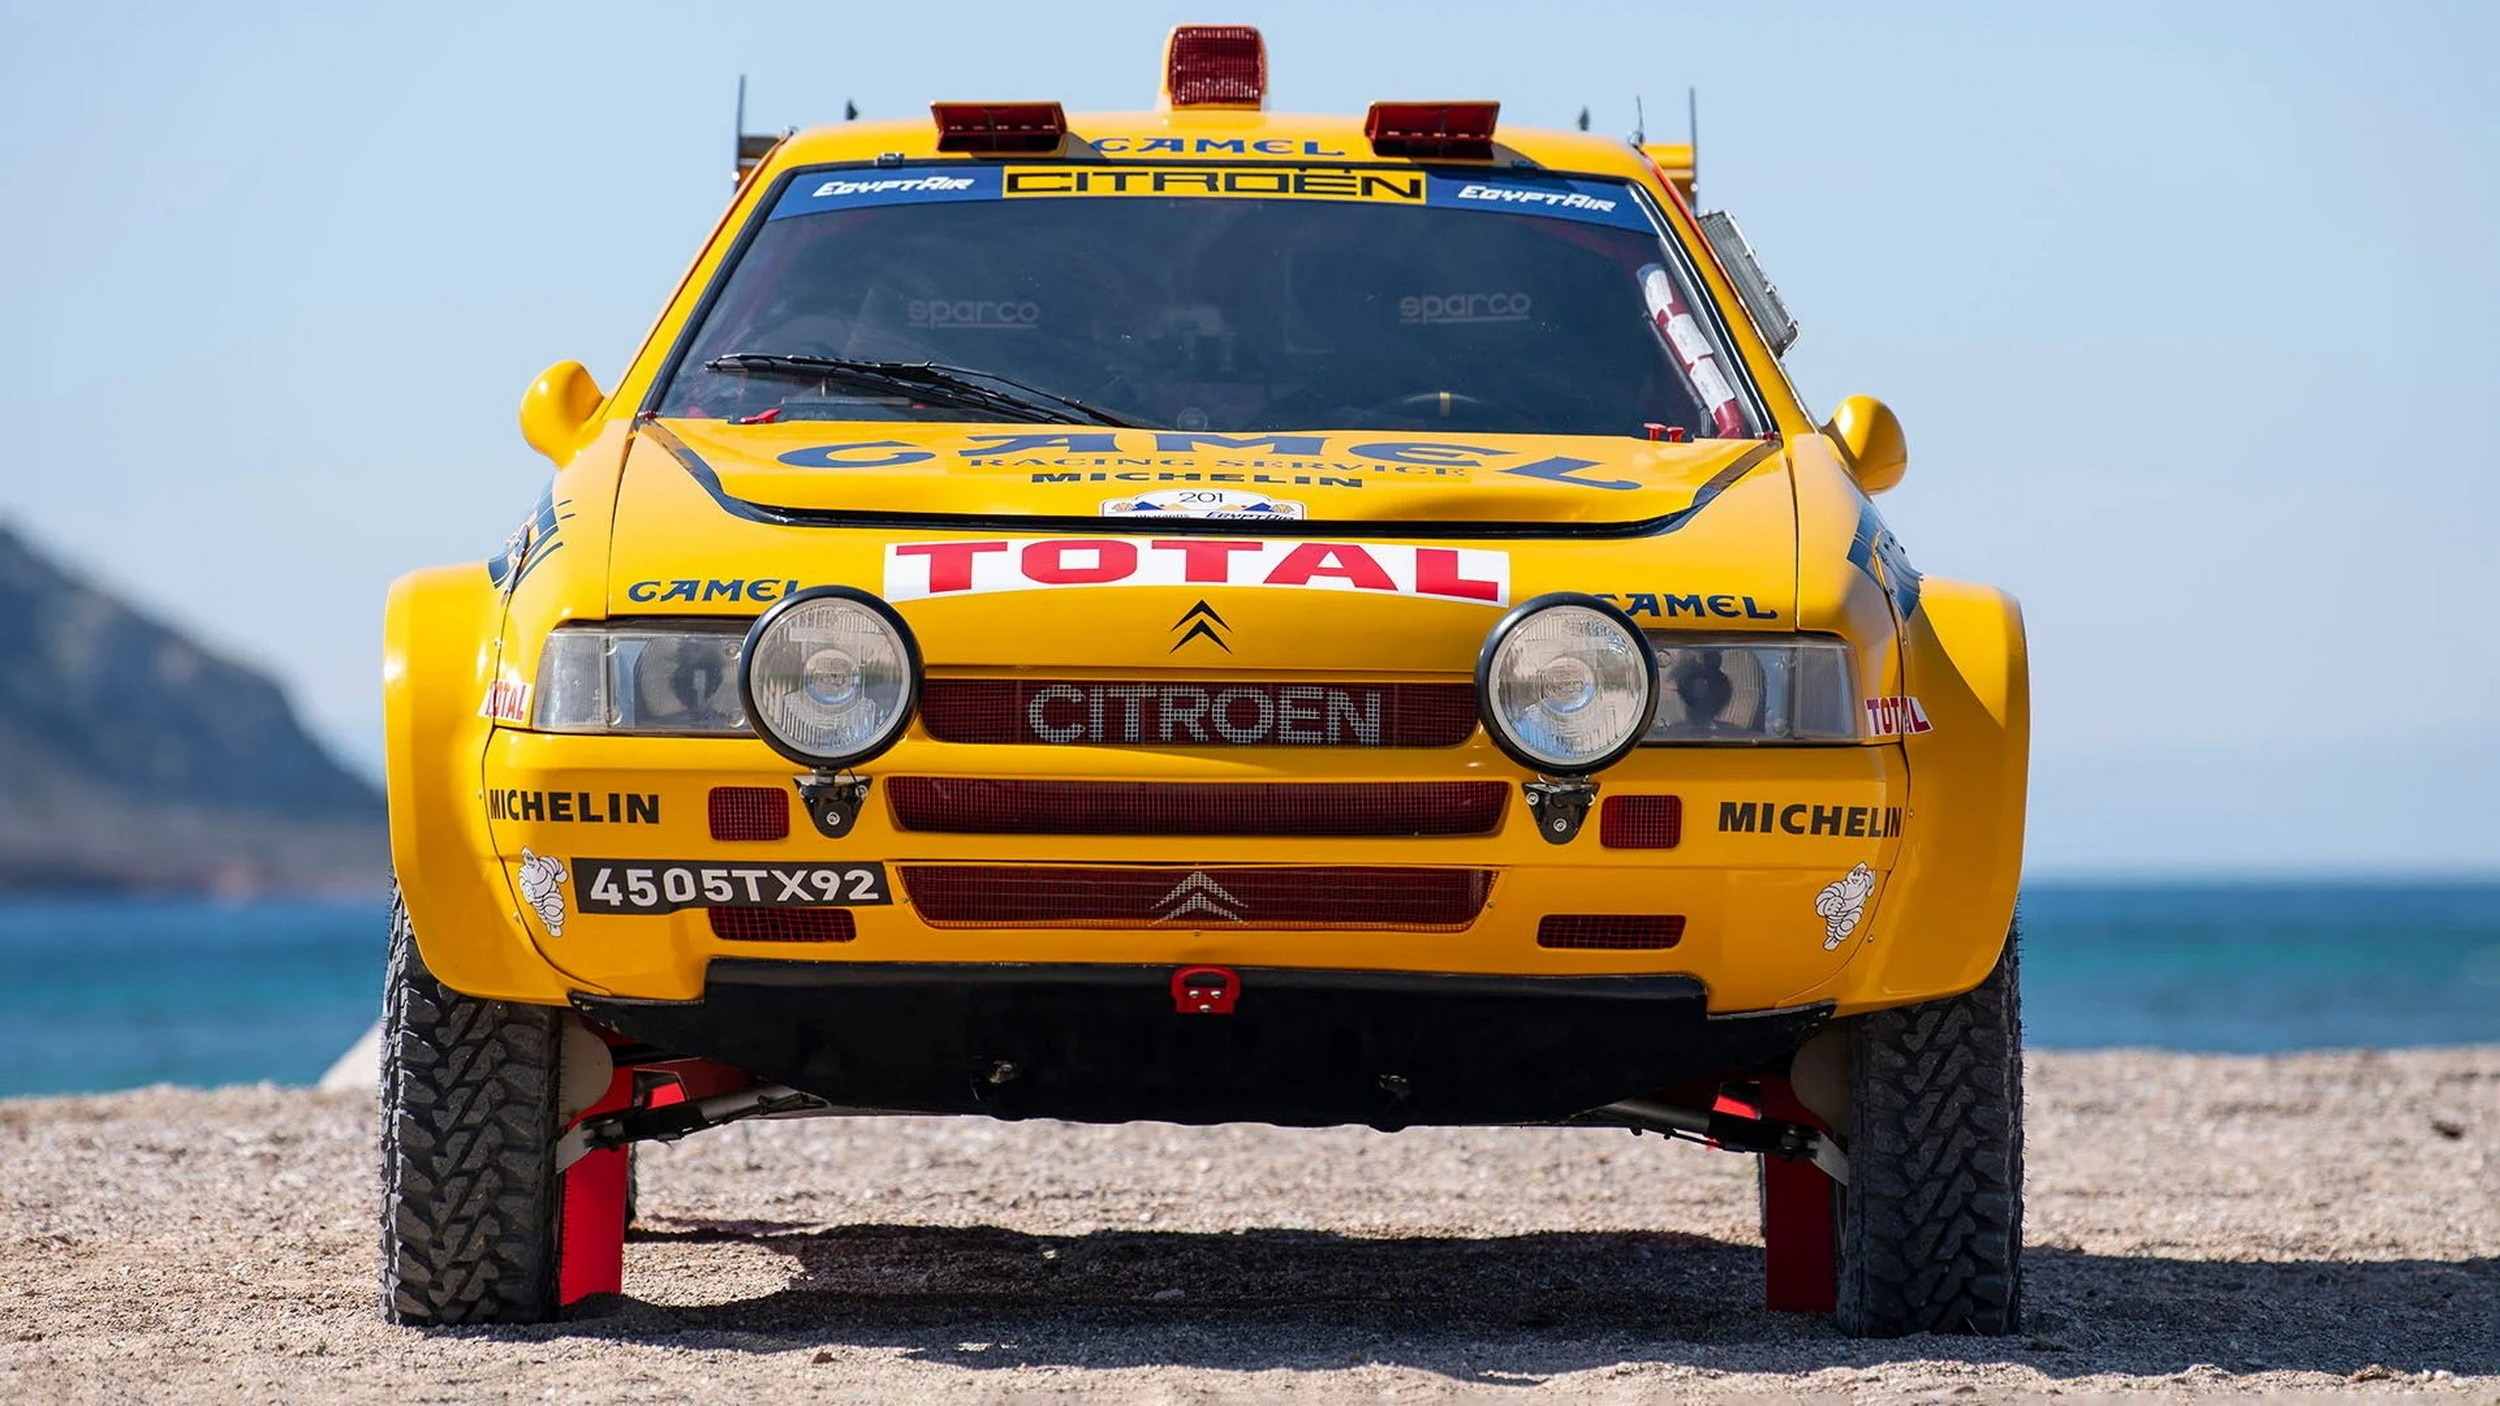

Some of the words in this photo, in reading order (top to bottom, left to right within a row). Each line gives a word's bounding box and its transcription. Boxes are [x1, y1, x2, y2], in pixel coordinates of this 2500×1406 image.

[1091, 137, 1346, 156] CAMEL
[908, 299, 1040, 330] sparco
[1399, 292, 1532, 326] sparco
[777, 432, 1643, 491] CAMEL
[969, 458, 1195, 467] RACING
[1216, 460, 1466, 478] SERVICE
[1031, 472, 1363, 489] MICHELIN
[1179, 492, 1223, 503] 201
[895, 538, 1499, 602] TOTAL
[1594, 593, 1778, 620] AMEL
[485, 681, 525, 721] TOTAL
[1028, 684, 1381, 745] CITROEN
[1866, 697, 1932, 735] TOTAL
[489, 789, 660, 824] MICHELIN
[1718, 801, 1902, 838] MICHELIN
[590, 867, 880, 907] 4505TX92
